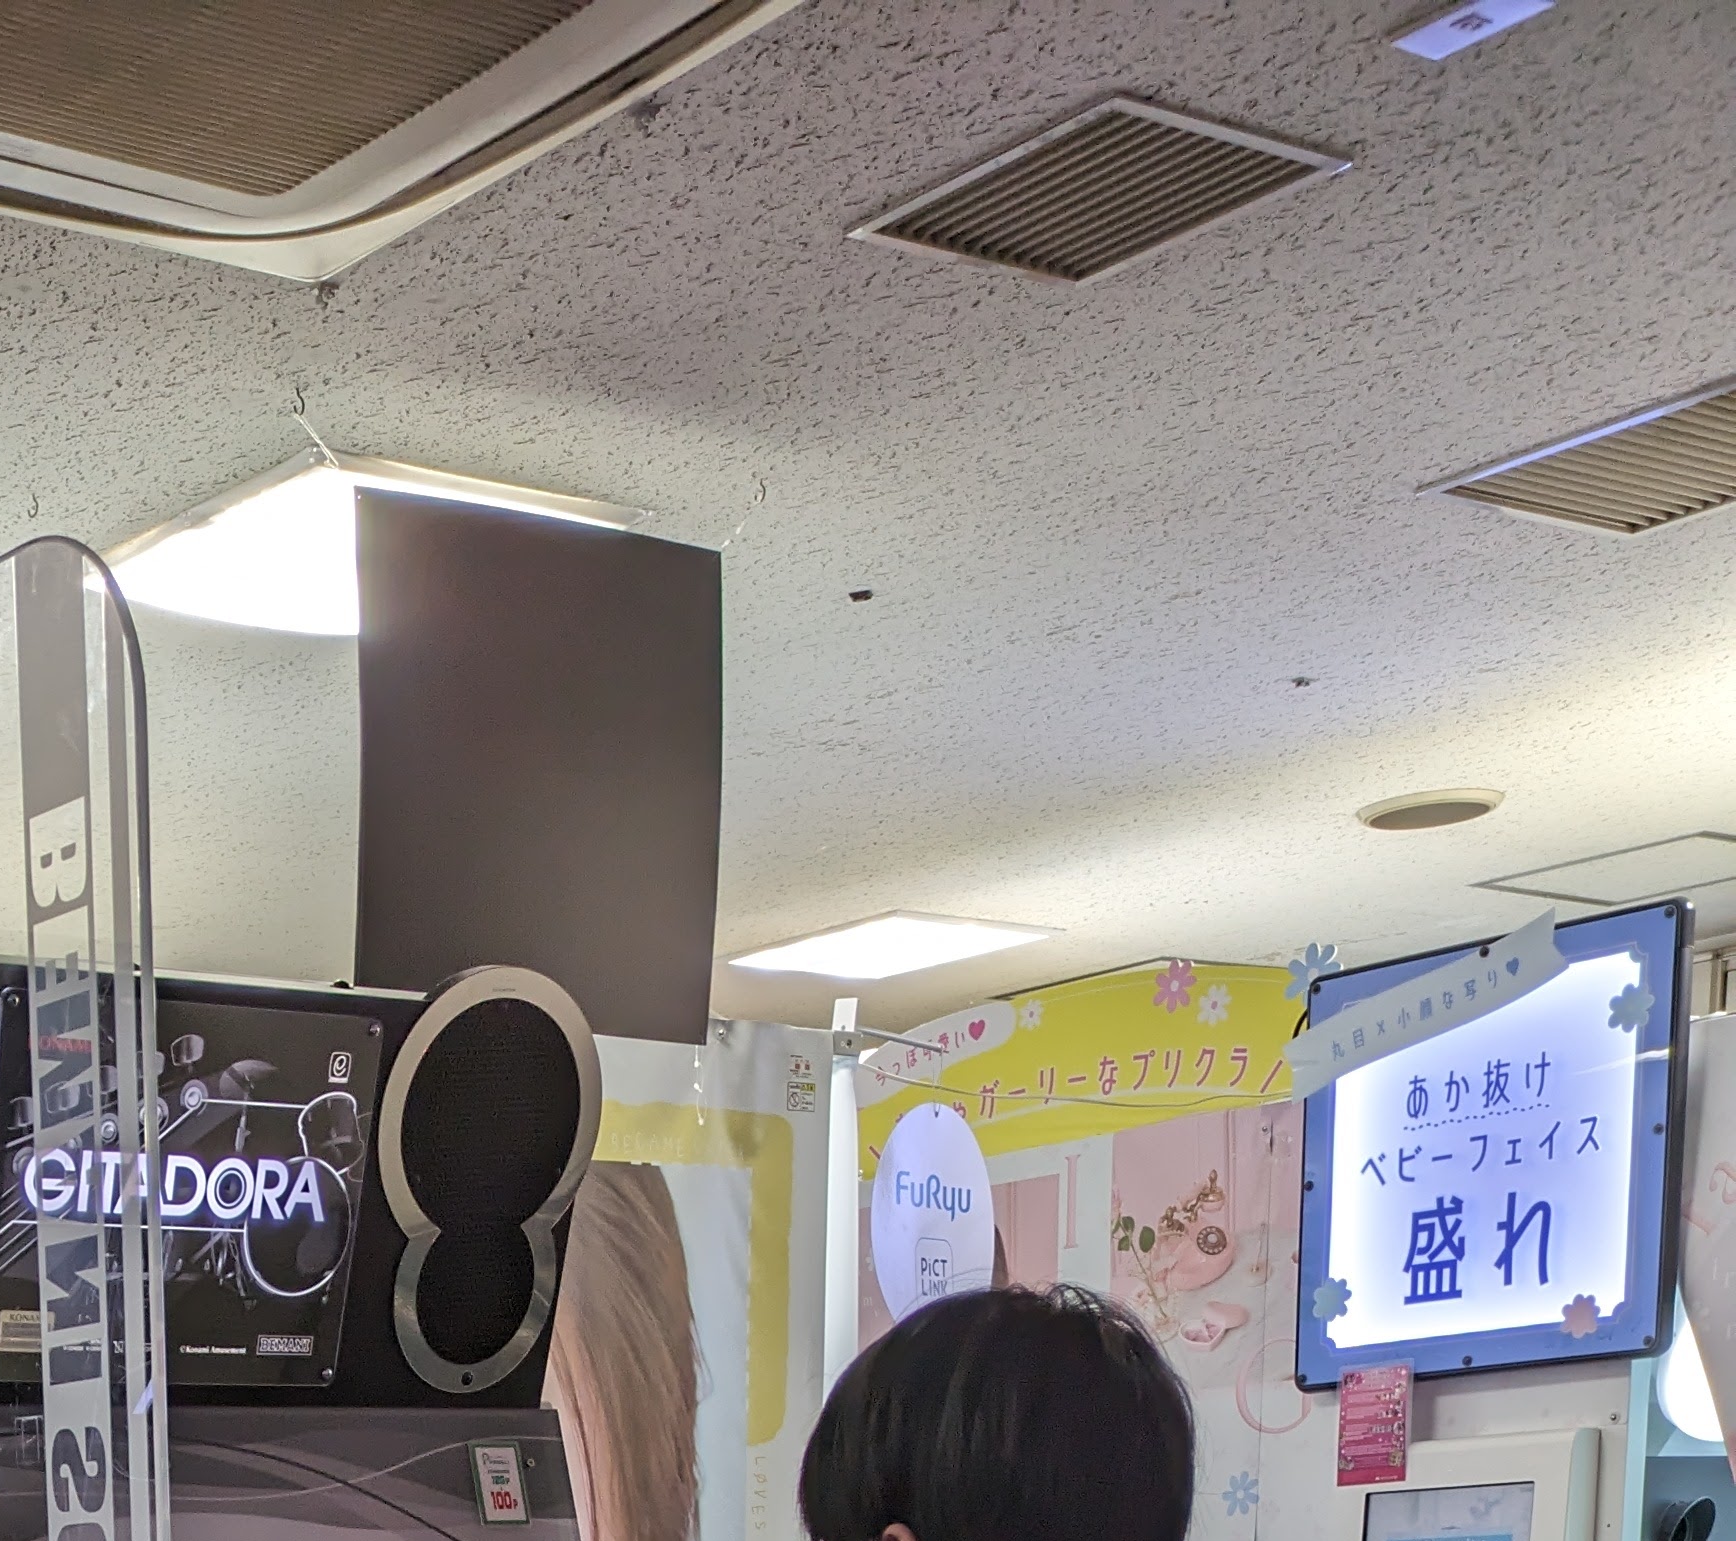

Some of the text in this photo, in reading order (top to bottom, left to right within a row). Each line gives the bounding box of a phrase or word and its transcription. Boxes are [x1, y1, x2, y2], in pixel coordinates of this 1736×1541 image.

[1406, 1051, 1552, 1120] あか抜け
[1360, 1116, 1601, 1186] ベビーフェイス
[895, 1170, 972, 1222] FuRyu
[1403, 1191, 1552, 1306] 盛れ
[921, 1280, 948, 1297] LINK
